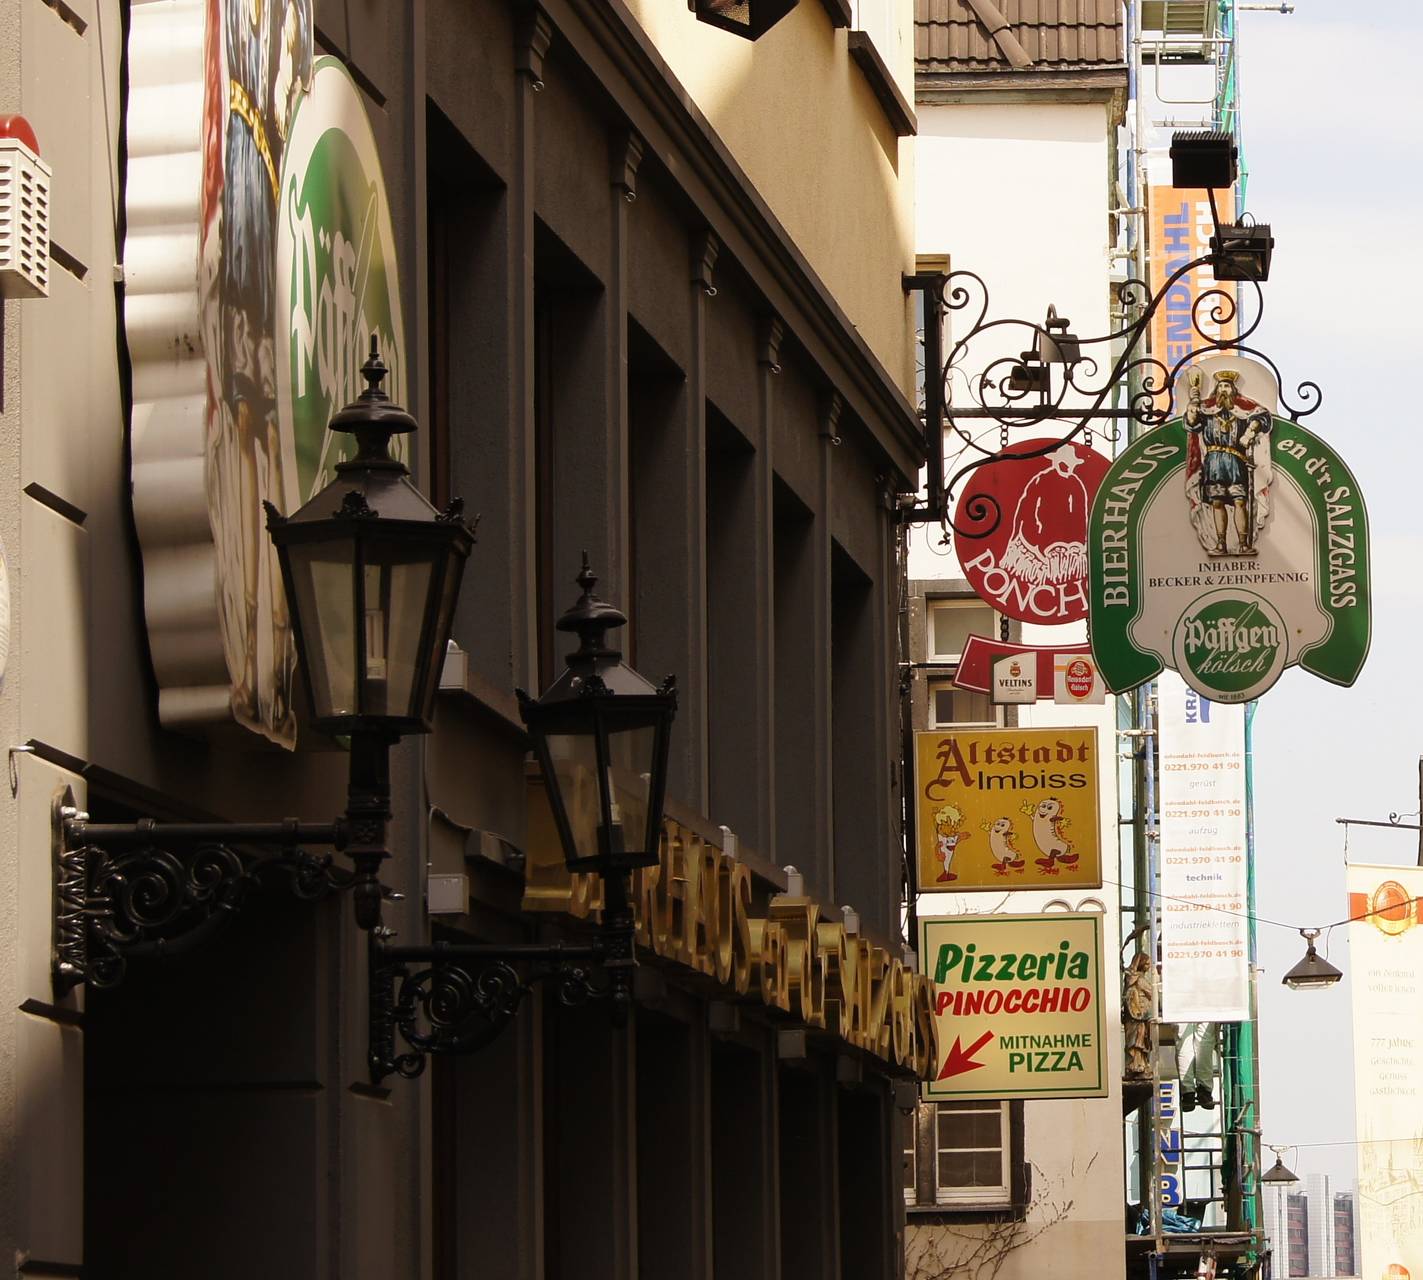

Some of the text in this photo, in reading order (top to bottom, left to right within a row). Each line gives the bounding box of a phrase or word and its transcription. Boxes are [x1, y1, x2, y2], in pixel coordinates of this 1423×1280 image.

[1103, 442, 1180, 608] BIERHAUS
[1277, 437, 1308, 461] en
[1324, 486, 1357, 608] SALZGASS
[1199, 561, 1261, 573] INHABER:
[964, 548, 1088, 617] PONCH
[1149, 572, 1309, 588] BECKER & ZEHNPFENNIG
[1184, 604, 1280, 654] Päffgen
[999, 679, 1033, 688] VELTINS
[925, 738, 1090, 801] Altstadt
[1227, 762, 1240, 770] 90
[978, 769, 1087, 790] Imbiss
[1227, 809, 1241, 817] 90
[1229, 855, 1241, 863] 90
[1186, 874, 1223, 882] technik
[1229, 902, 1242, 911] 90
[1230, 949, 1244, 958] 90
[935, 940, 1089, 984] Pizzeria
[935, 986, 1091, 1017] PINOCCHIO
[999, 1033, 1092, 1050] MITNAHME
[1008, 1051, 1083, 1074] PIZZA
